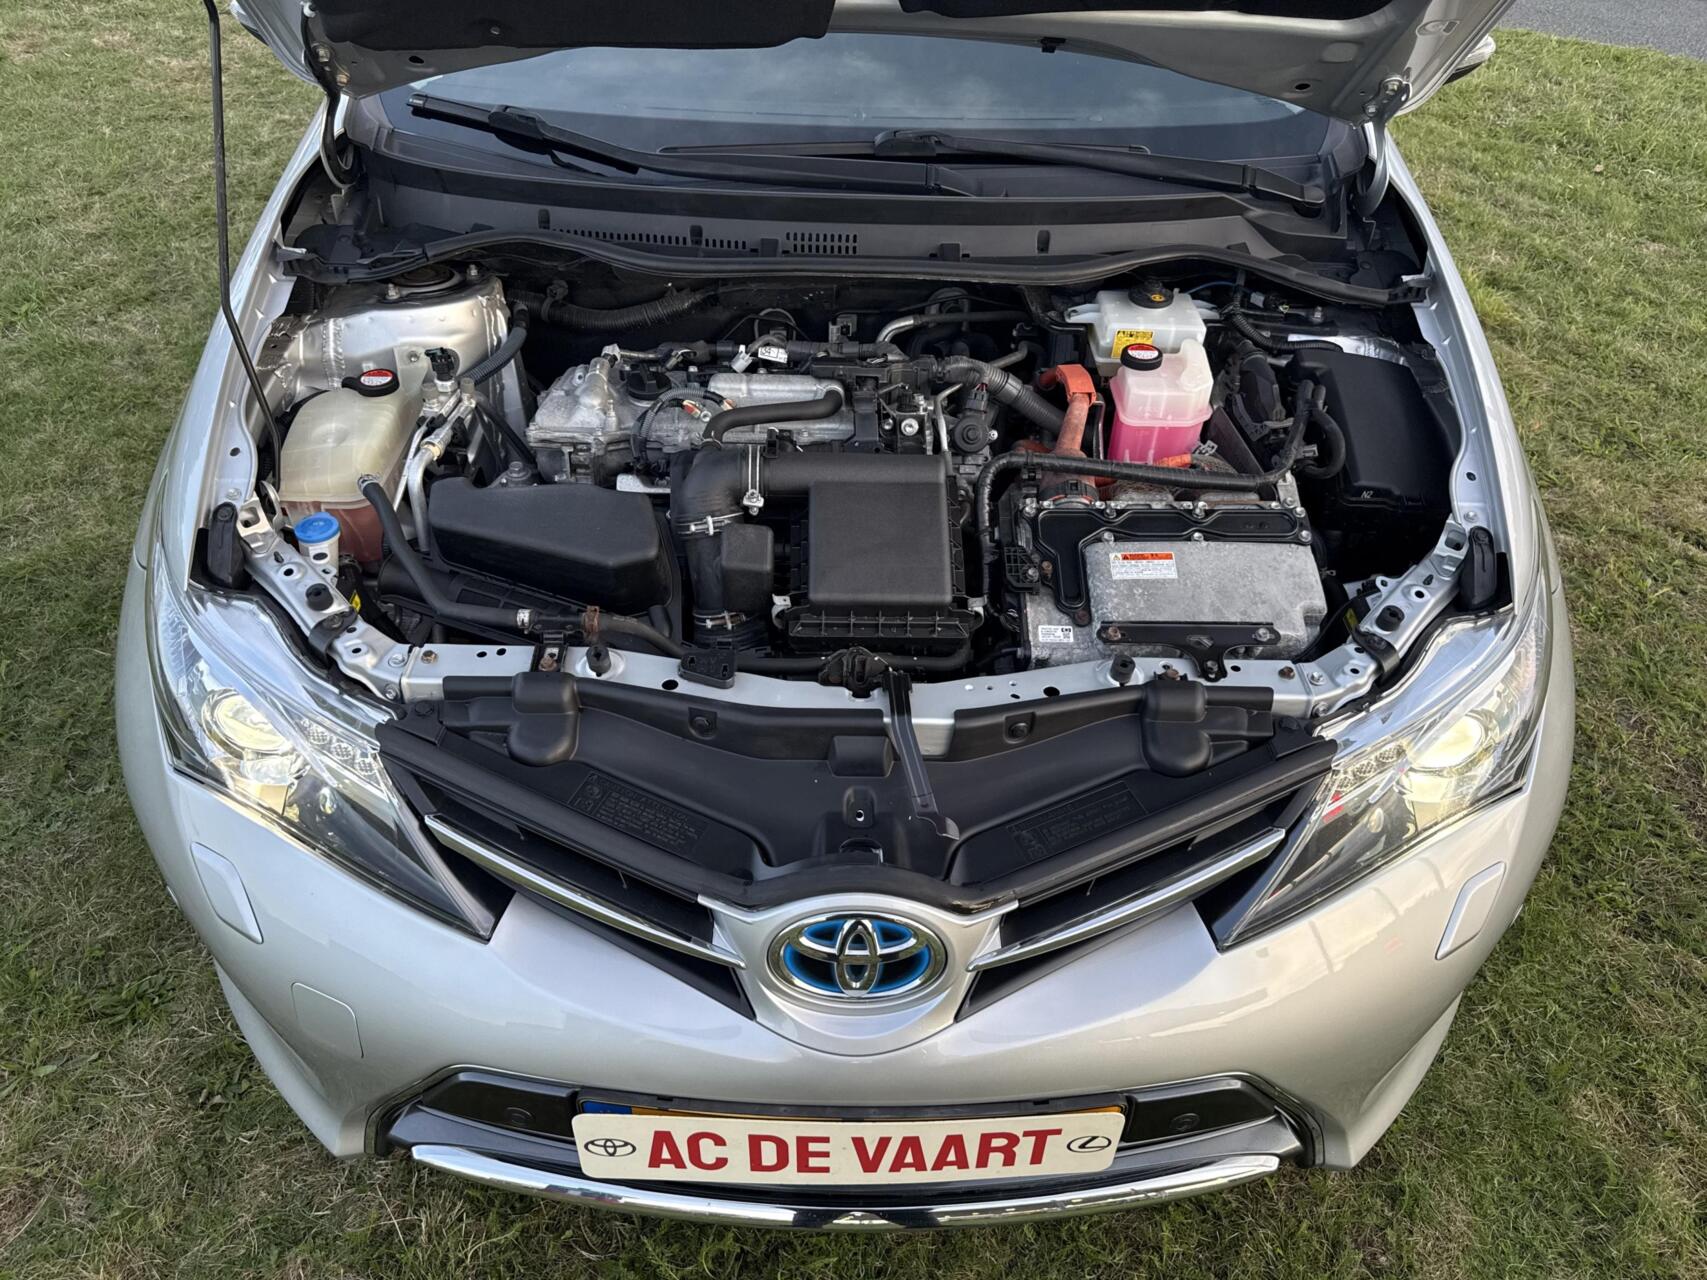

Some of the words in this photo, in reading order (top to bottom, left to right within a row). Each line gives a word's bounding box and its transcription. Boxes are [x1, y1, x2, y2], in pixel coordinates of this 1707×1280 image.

[648, 1130, 729, 1171] AC
[748, 1134, 831, 1173] DE
[851, 1128, 1063, 1173] VAART
